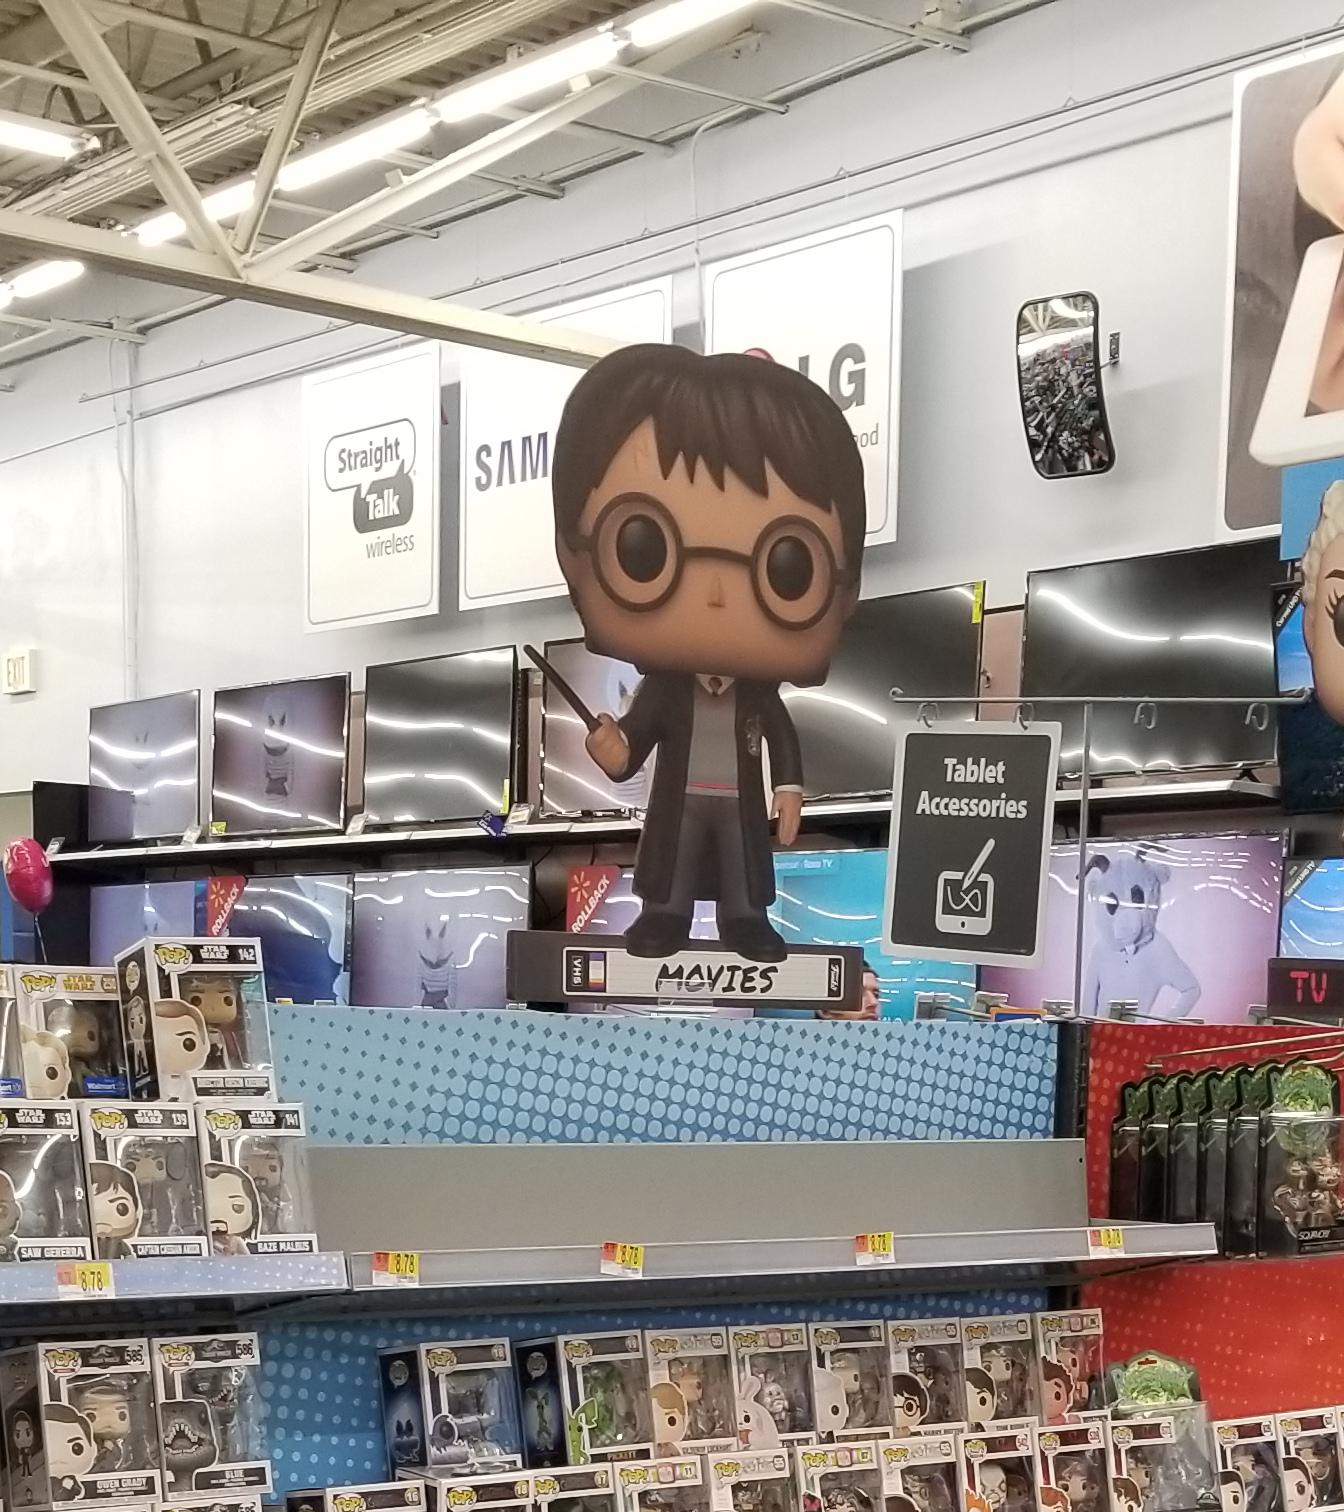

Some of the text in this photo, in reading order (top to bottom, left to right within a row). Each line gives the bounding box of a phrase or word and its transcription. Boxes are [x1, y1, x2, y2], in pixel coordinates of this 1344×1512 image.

[338, 436, 400, 474] Straight
[365, 488, 400, 521] Talk
[366, 533, 415, 559] wireless
[944, 757, 1005, 785] Tablet
[916, 790, 1028, 819] Accessories
[570, 873, 611, 934] ROLLBACK
[573, 957, 583, 986] VHS
[656, 963, 779, 994] MOVIES
[1290, 971, 1328, 1002] TV
[81, 1270, 104, 1291] 8.78
